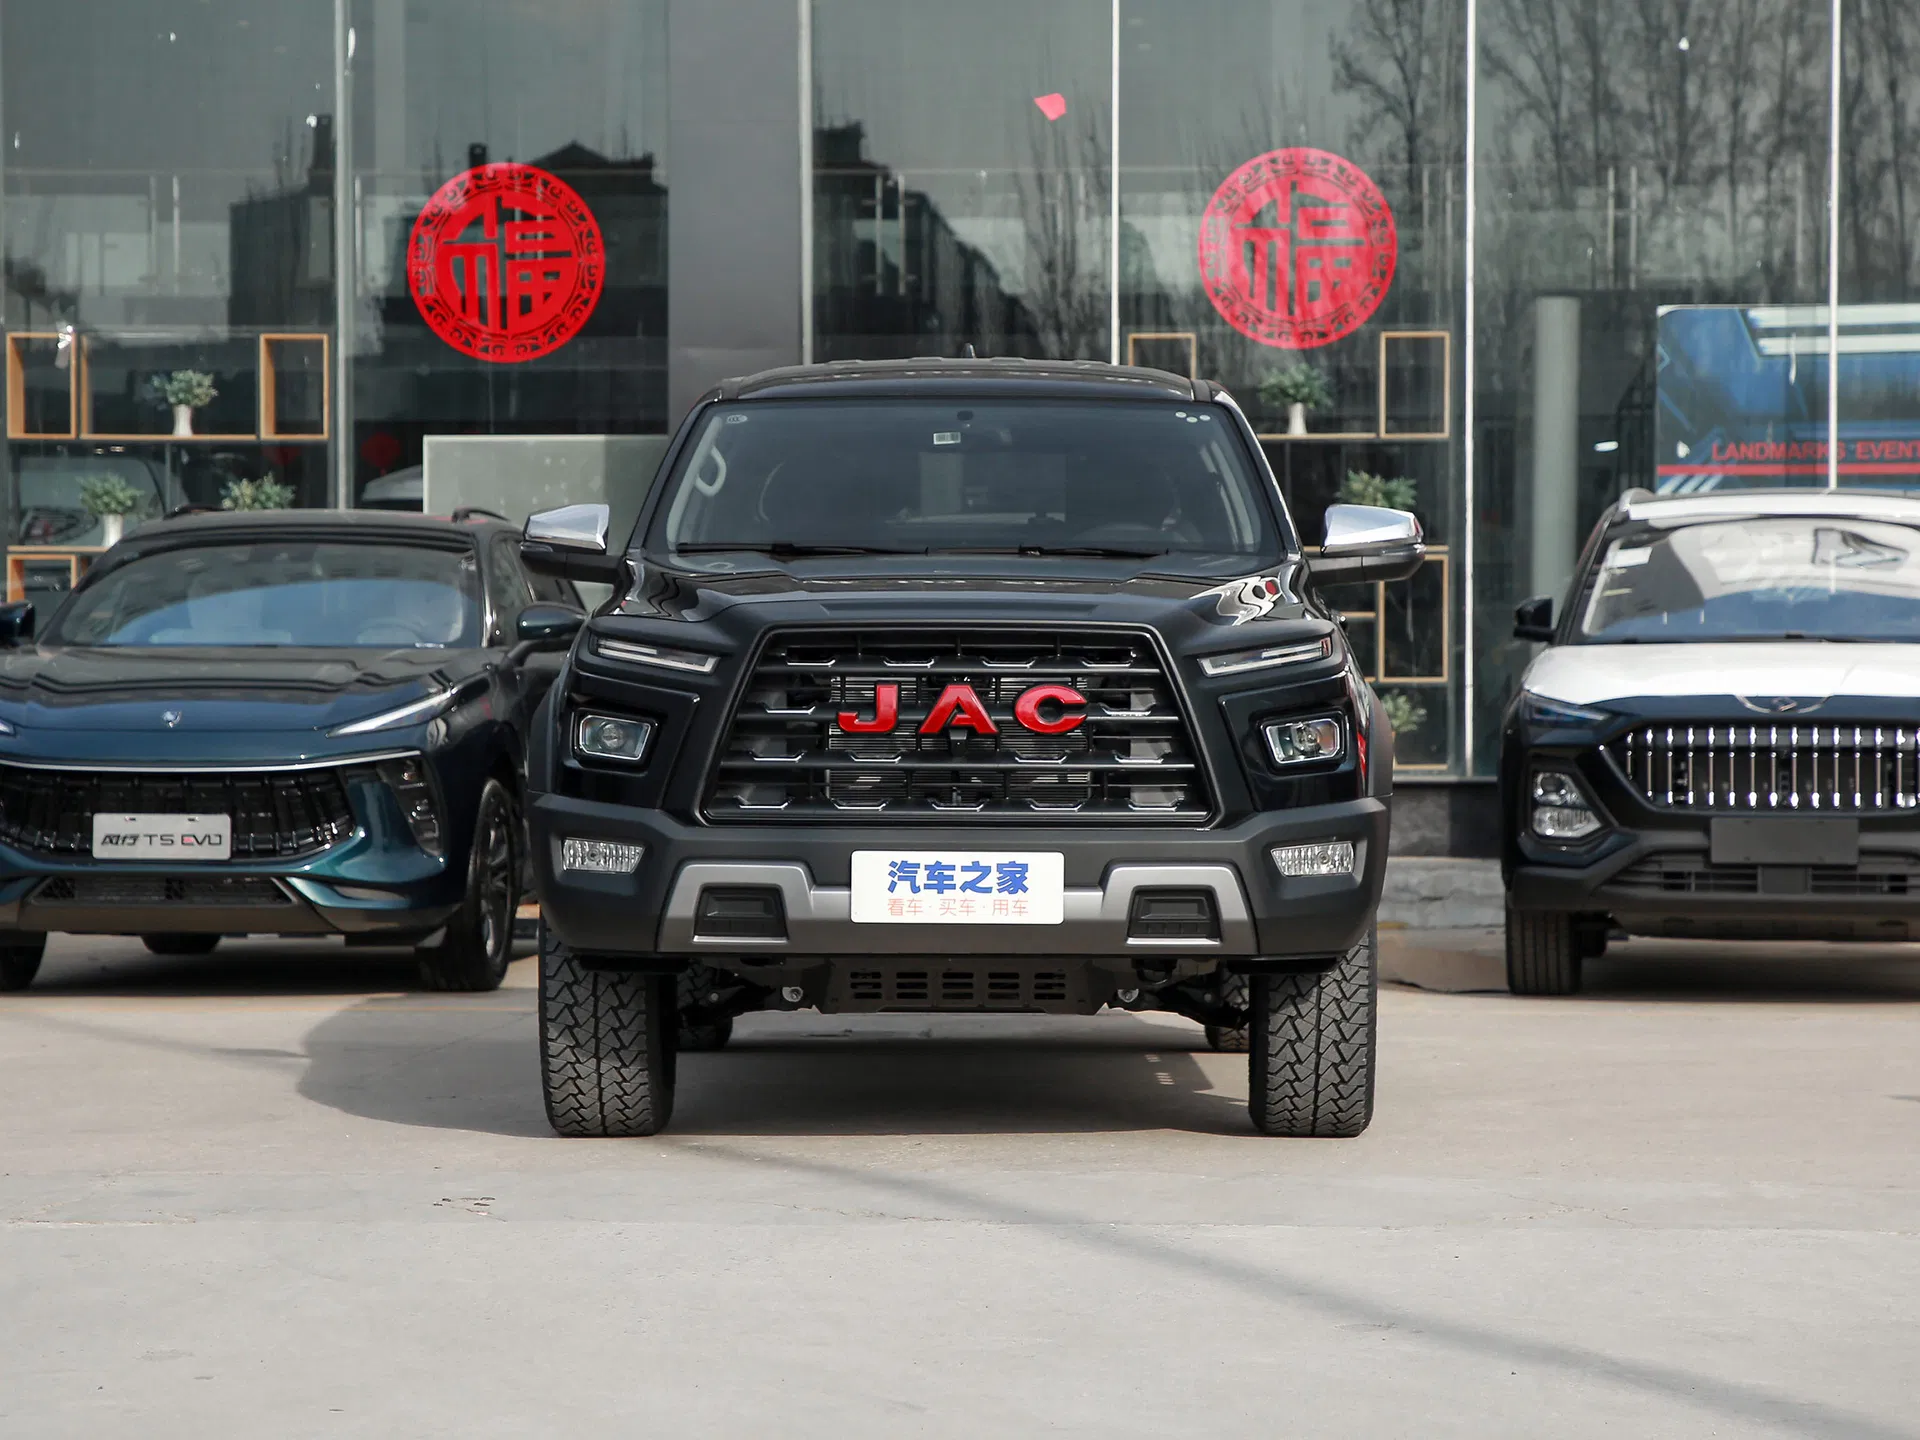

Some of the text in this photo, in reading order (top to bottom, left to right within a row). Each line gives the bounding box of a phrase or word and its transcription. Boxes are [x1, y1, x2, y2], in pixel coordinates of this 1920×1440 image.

[443, 196, 573, 330] 福
[1234, 180, 1365, 316] 福
[837, 684, 1087, 734] JAC
[887, 860, 1029, 895] 汽车之家
